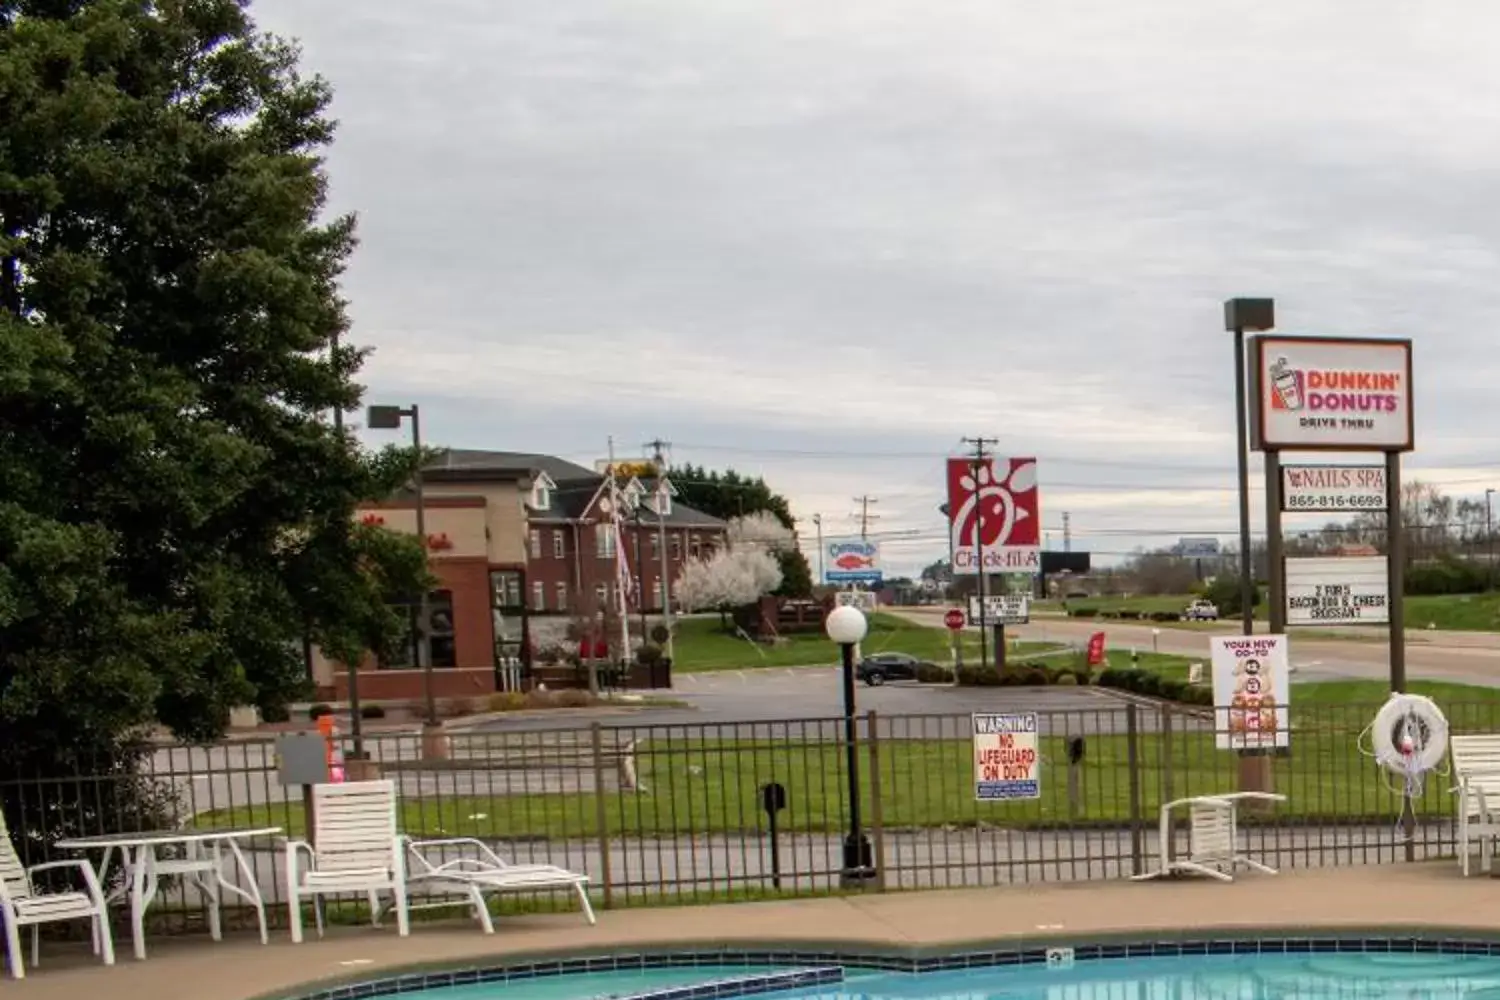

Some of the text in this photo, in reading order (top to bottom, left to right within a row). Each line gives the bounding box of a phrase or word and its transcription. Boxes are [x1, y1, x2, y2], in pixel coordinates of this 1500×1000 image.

[1307, 369, 1400, 391] DUNKIN'
[1308, 393, 1397, 413] DONUTS
[1300, 416, 1374, 430] DRIVE THRU
[1303, 469, 1354, 488] NAILS
[1358, 469, 1384, 489] SPA
[956, 551, 1038, 567] Chck-fil-A
[1326, 585, 1342, 596] FOR
[1224, 640, 1251, 649] YOUR
[976, 716, 1033, 733] WARNING
[1000, 733, 1014, 748] NO
[979, 748, 1034, 765] LIFEGUARD
[984, 764, 1029, 780] ON DUTY
